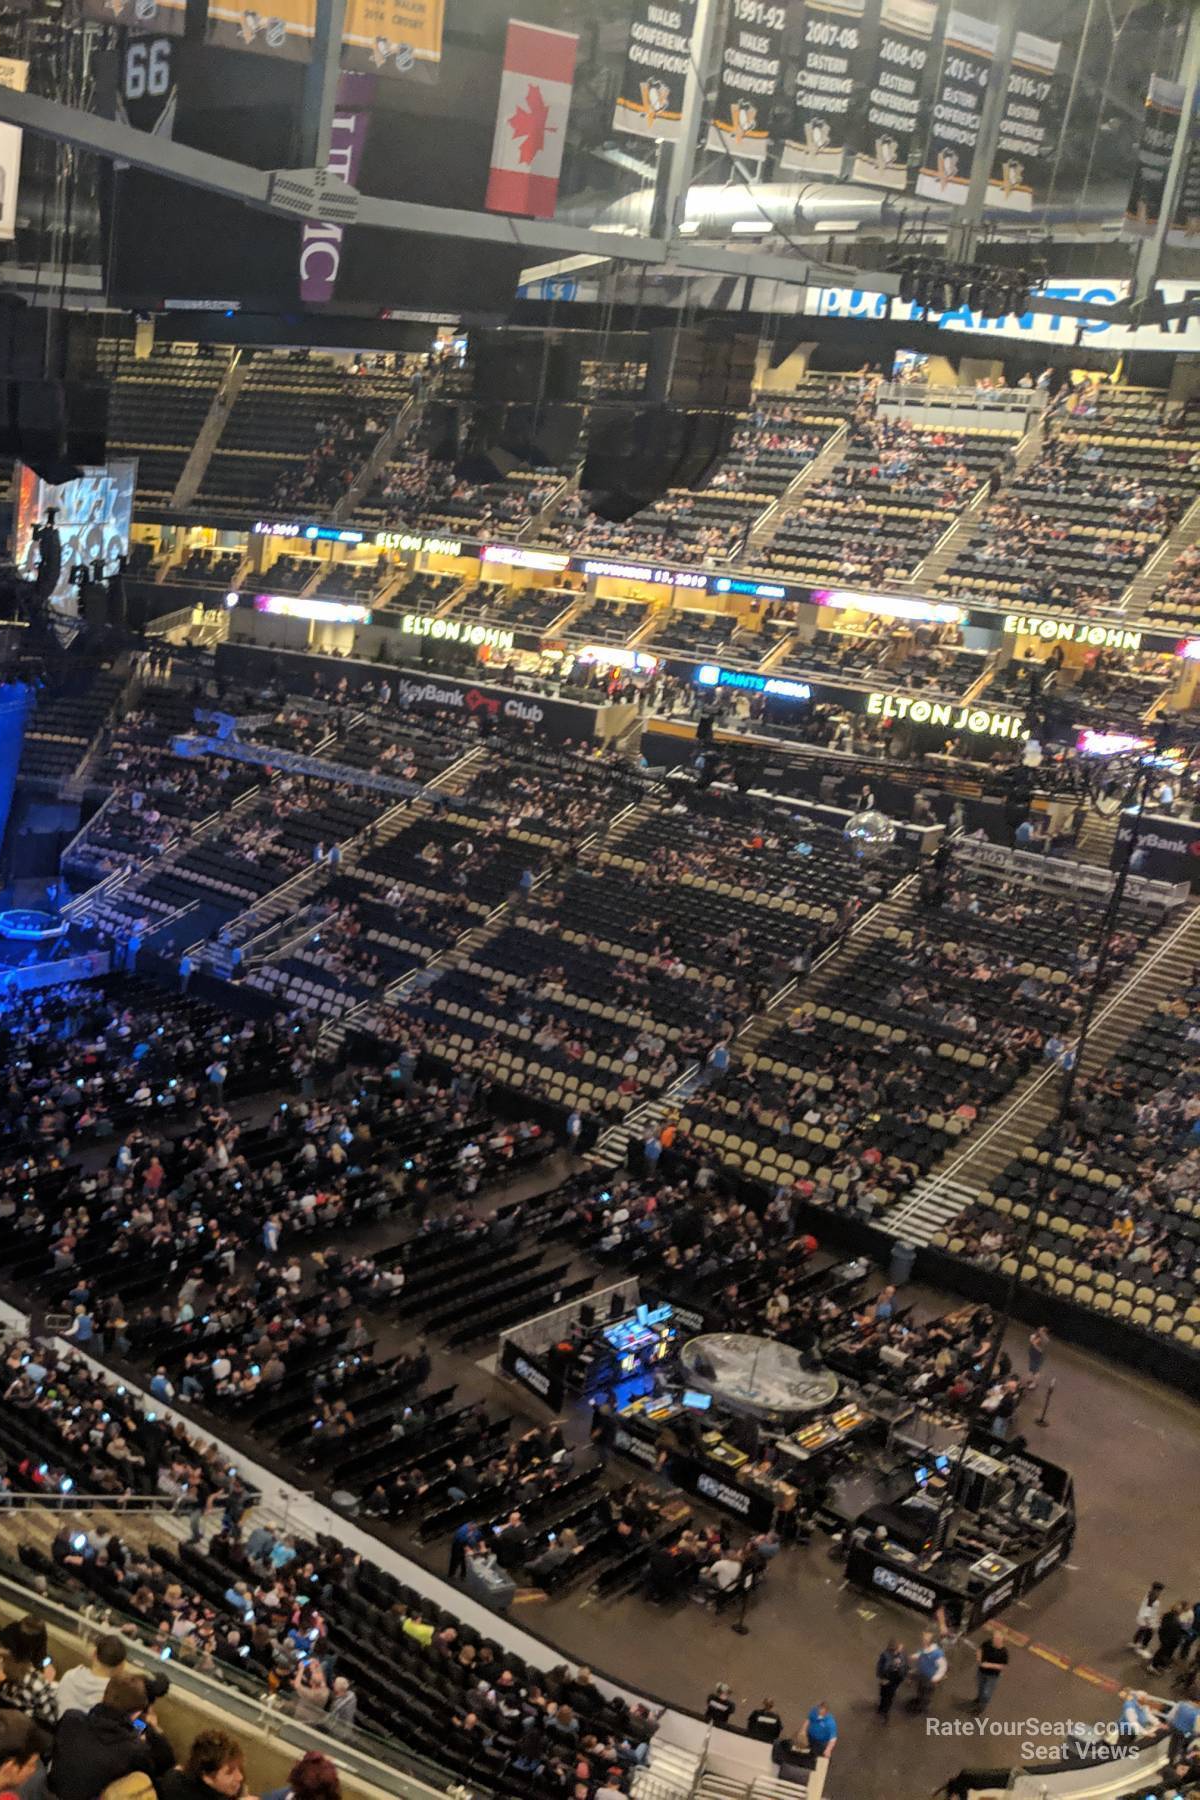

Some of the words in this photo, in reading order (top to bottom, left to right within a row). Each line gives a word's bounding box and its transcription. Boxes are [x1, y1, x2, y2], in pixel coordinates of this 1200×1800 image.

[648, 5, 682, 29] WALES
[734, 0, 786, 30] 1991-92
[630, 22, 692, 53] CONFERENC
[739, 31, 771, 54] WALES
[804, 20, 859, 50] 2007-08
[125, 38, 171, 99] 66
[628, 44, 690, 74] CHAMPIONS
[724, 48, 780, 75] CONFERENCE
[806, 52, 848, 74] EASTERN
[879, 38, 927, 70] 2008-09
[723, 68, 777, 96] CHAMPIONS
[1007, 74, 1052, 101] 2016-17
[376, 532, 422, 551] ELTON
[421, 538, 462, 557] JOHN
[675, 573, 708, 588] 2019
[402, 614, 461, 640] ELTON
[460, 625, 515, 649] JOHN
[1003, 615, 1075, 641] ELTON
[1075, 625, 1142, 650] JOHN
[720, 671, 765, 690] PAINTS
[399, 679, 465, 708] KeyBank
[504, 700, 544, 723] Club
[866, 692, 952, 727] ELTON
[1118, 828, 1189, 854] KyBank
